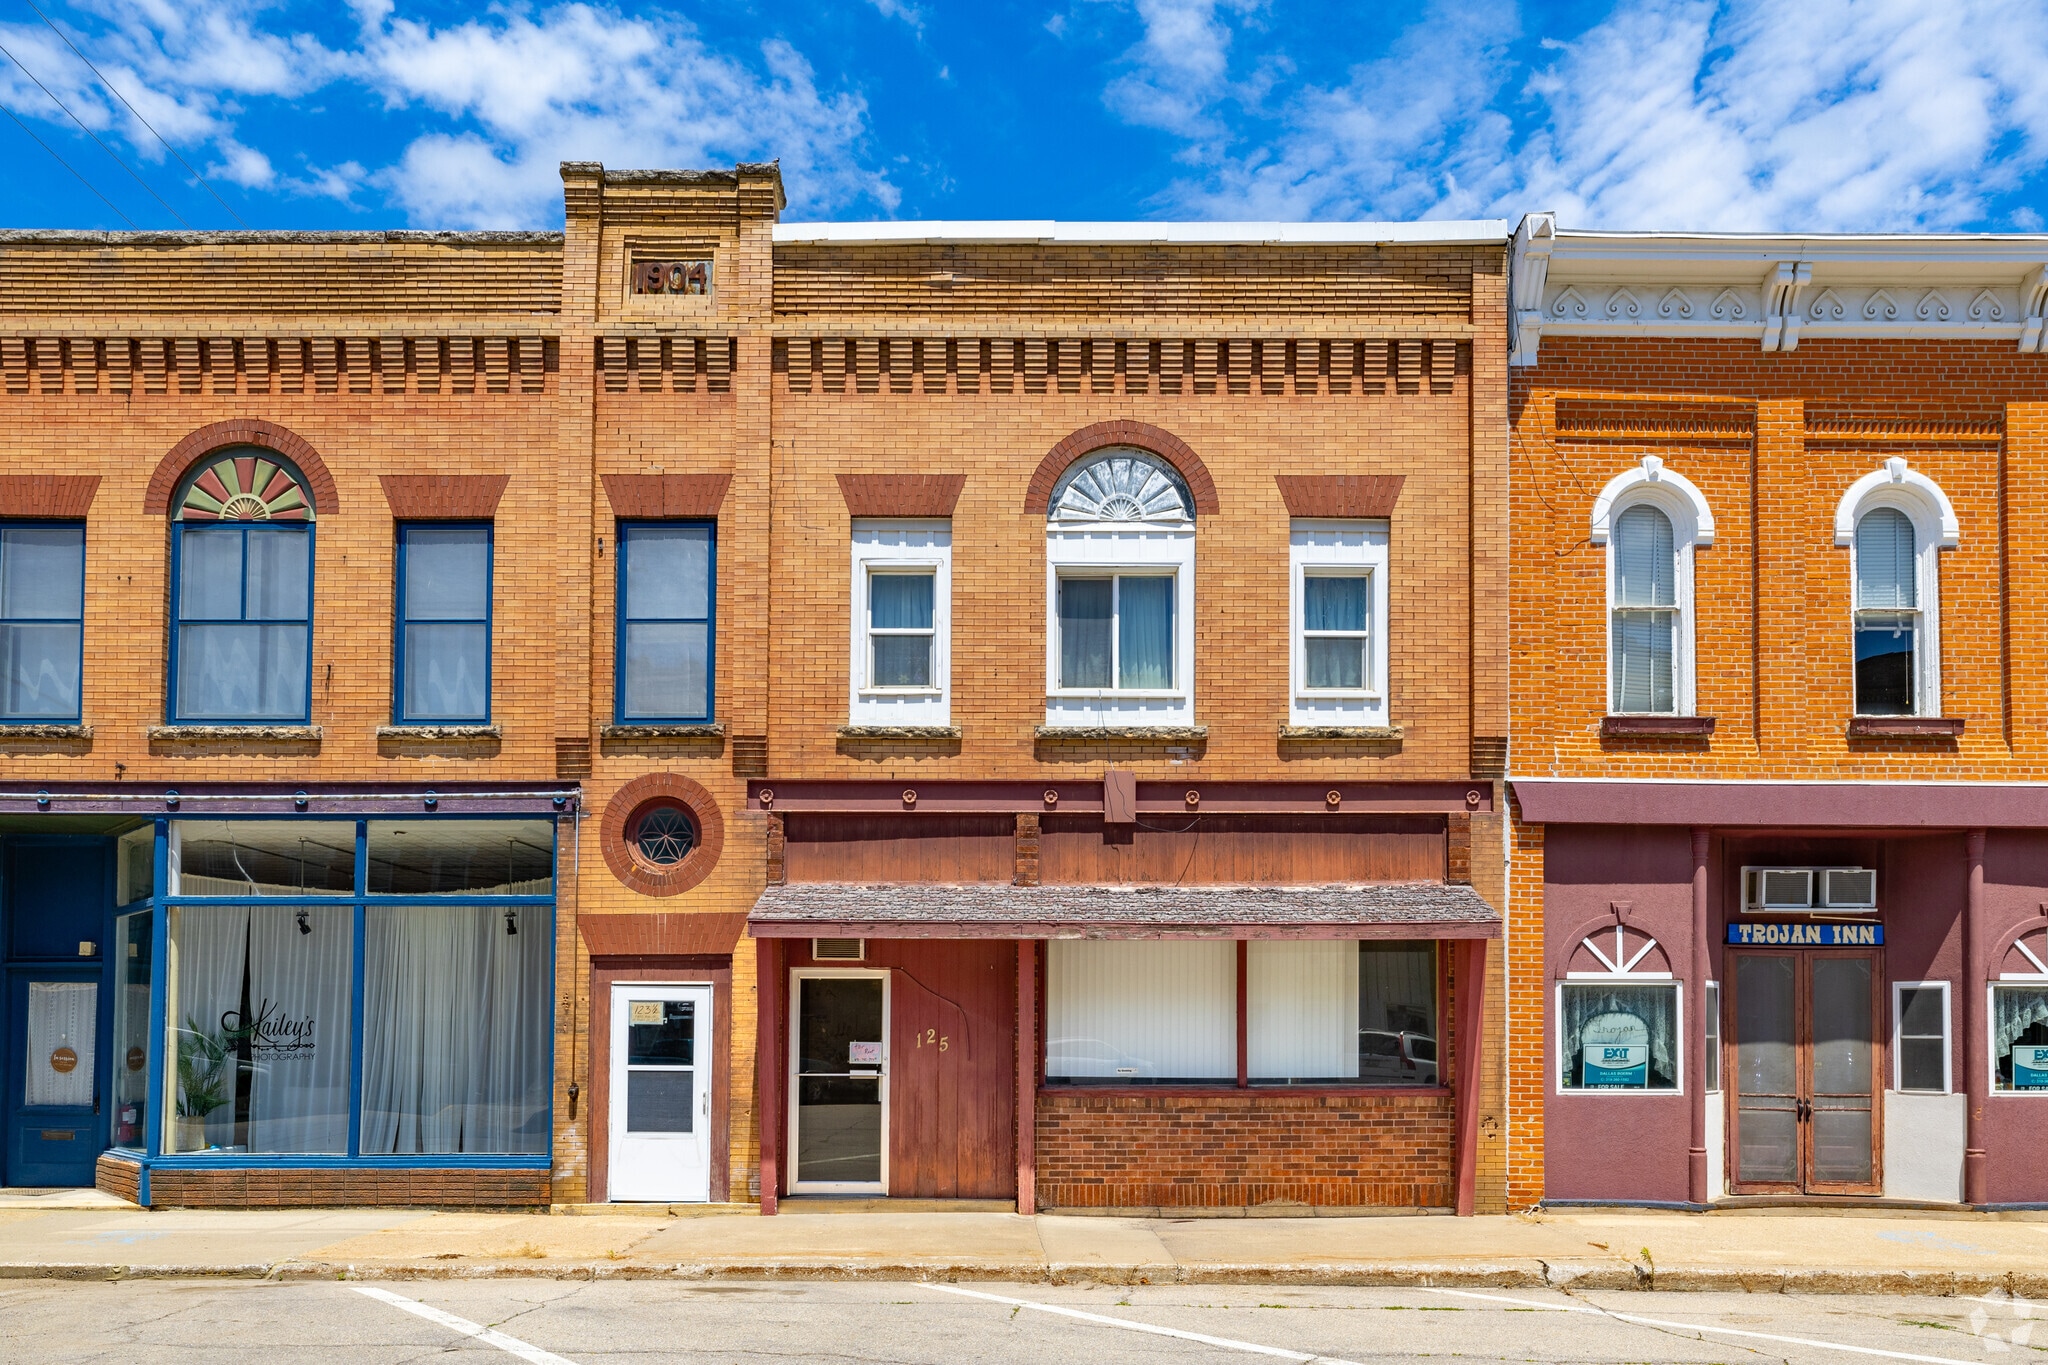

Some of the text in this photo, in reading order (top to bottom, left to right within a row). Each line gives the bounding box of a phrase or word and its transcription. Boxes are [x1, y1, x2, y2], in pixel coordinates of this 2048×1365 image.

[634, 262, 707, 294] 1904
[1738, 924, 1875, 945] TROJAN INN
[221, 998, 315, 1052] Kailey's
[1593, 1020, 1645, 1044] Trojan
[916, 1028, 950, 1052] 125
[251, 1052, 316, 1061] PHOTOGRAPHY
[1603, 1047, 1630, 1059] EXIT
